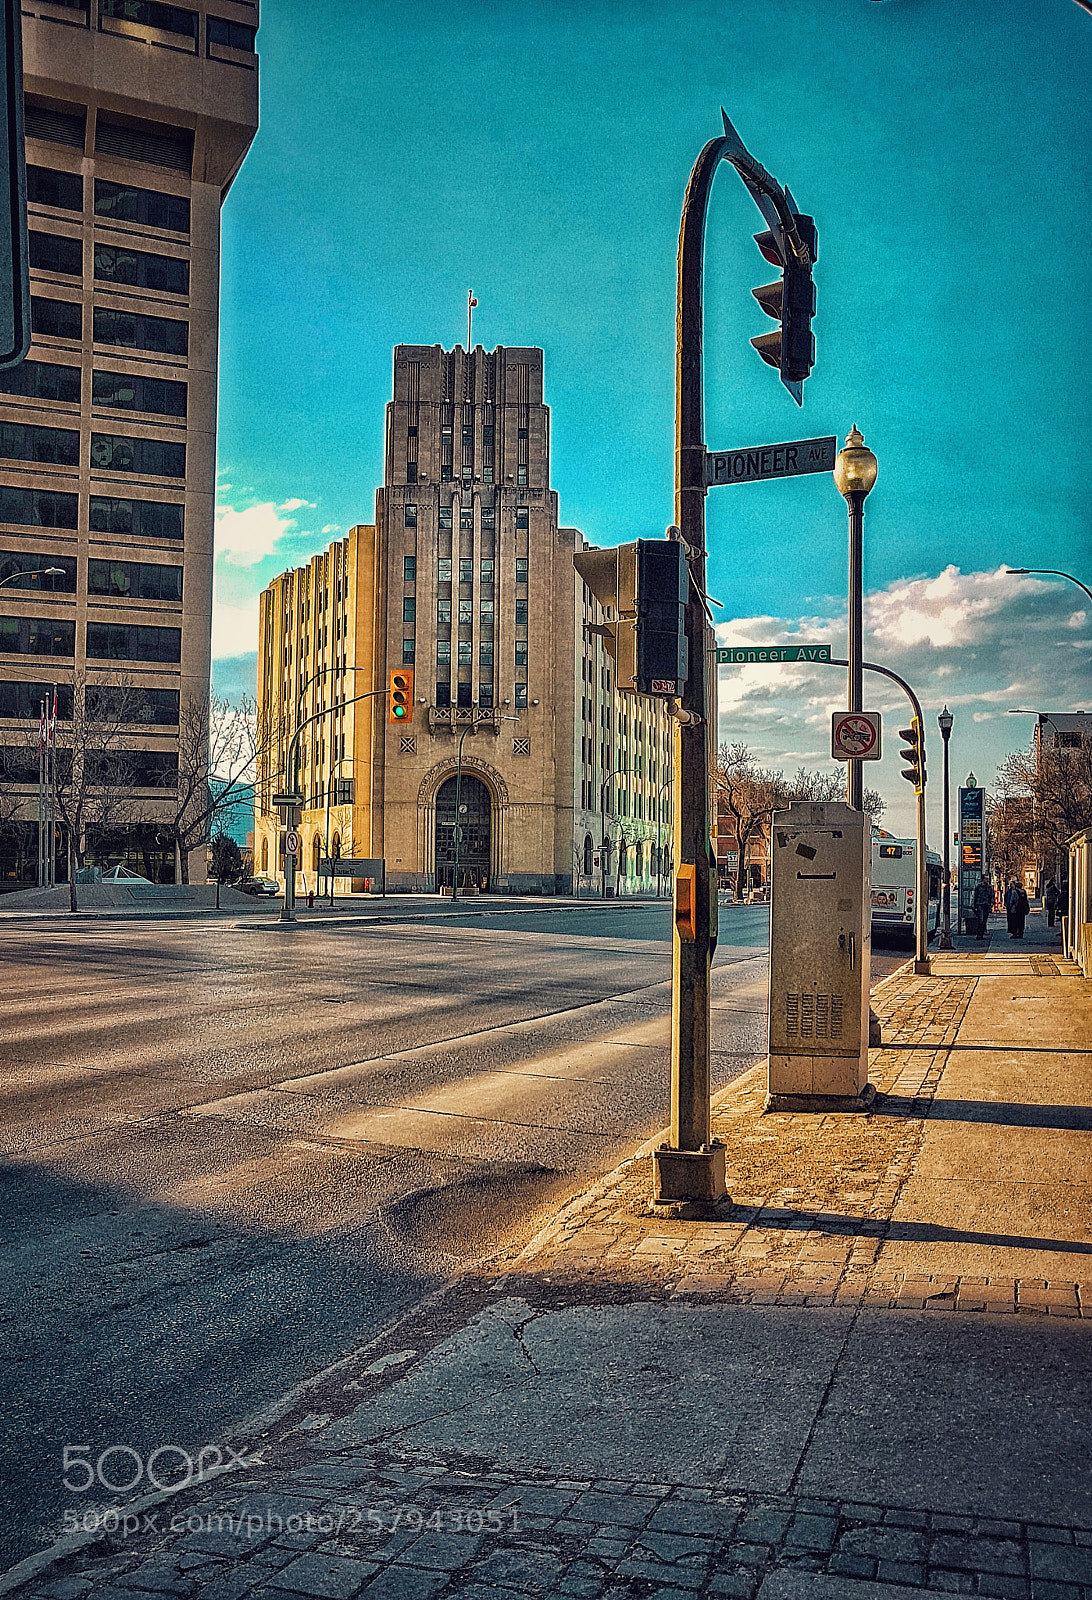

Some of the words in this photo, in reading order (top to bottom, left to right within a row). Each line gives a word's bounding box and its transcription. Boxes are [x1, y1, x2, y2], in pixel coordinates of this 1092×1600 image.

[714, 447, 799, 479] PIONEER
[808, 447, 828, 461] AVE
[719, 648, 787, 663] Pioneer
[796, 648, 828, 660] Ave
